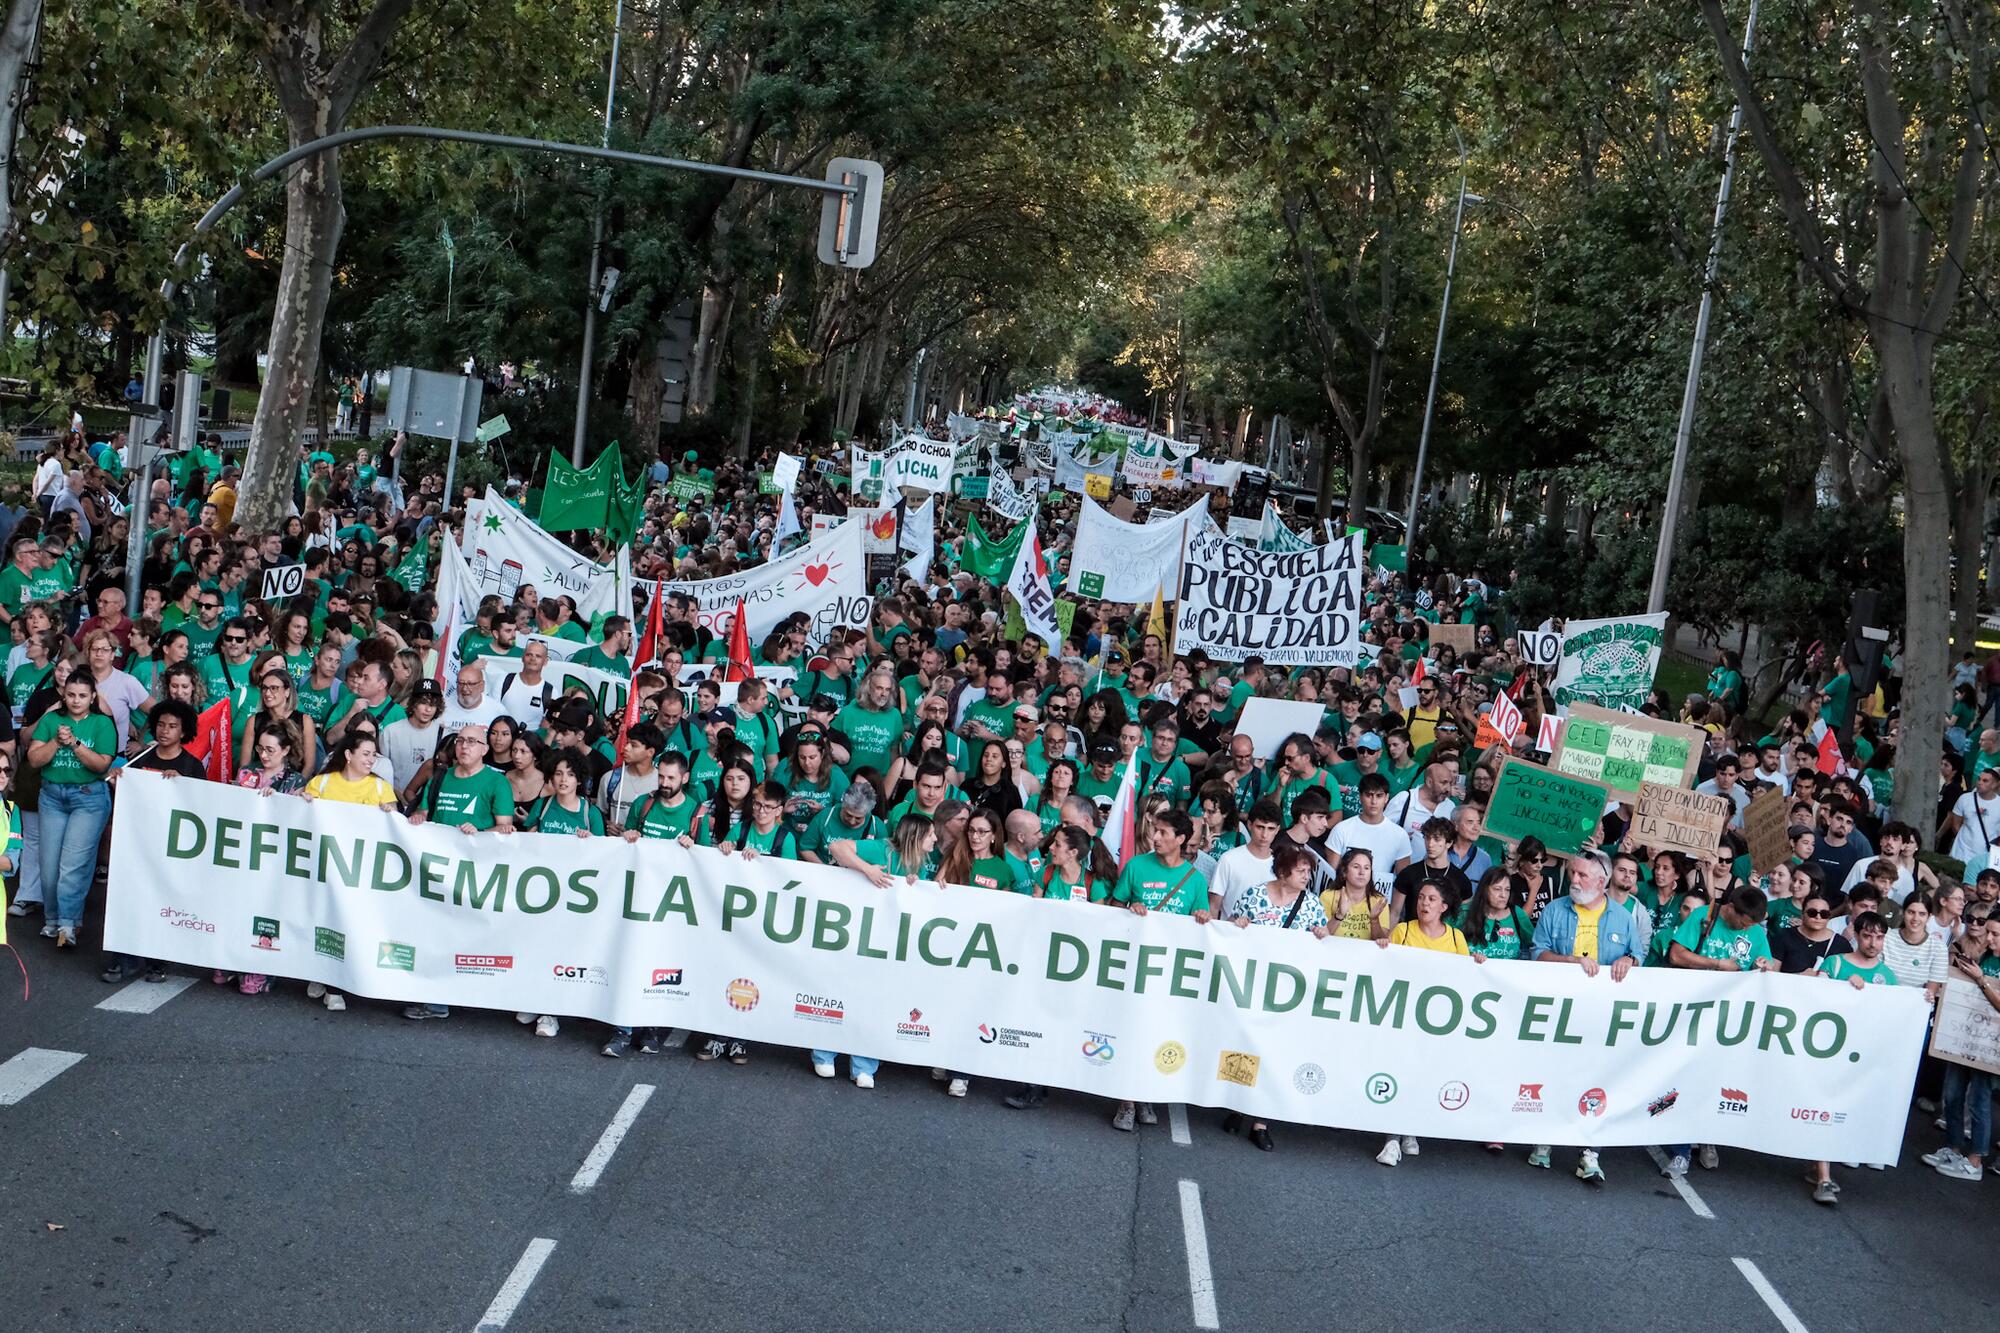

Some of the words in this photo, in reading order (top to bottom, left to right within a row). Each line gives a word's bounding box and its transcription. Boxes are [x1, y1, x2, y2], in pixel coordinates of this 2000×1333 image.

[1115, 426, 1144, 438] RAMIRO
[920, 444, 951, 459] OCHOA
[1127, 454, 1159, 469] ESCUELA
[553, 466, 580, 487] IES
[583, 489, 605, 499] scuela
[1134, 490, 1150, 501] NO
[1189, 529, 1207, 561] por
[1203, 538, 1224, 562] una
[1222, 536, 1357, 579] ESCUELA
[263, 566, 304, 597] NO
[700, 584, 773, 611] LUMNAS
[1417, 592, 1432, 608] NO
[834, 596, 869, 625] NO
[1179, 607, 1197, 631] de
[1519, 633, 1559, 662] NO
[1563, 625, 1612, 657] SOMOS
[1270, 650, 1299, 661] BRAVO
[1304, 650, 1353, 663] VALDEMORO
[1490, 690, 1519, 740] NO
[1538, 717, 1561, 748] N
[1567, 723, 1606, 747] CEE
[1611, 734, 1633, 750] FRAY
[1565, 751, 1602, 767] MADRID
[1623, 751, 1635, 761] DE
[1506, 769, 1546, 788] SOLO
[1549, 781, 1566, 793] CON
[1664, 769, 1676, 778] SE
[1516, 788, 1532, 799] NO
[1541, 792, 1551, 804] SE
[1559, 799, 1583, 813] HACE
[1642, 784, 1672, 802] SOLO
[1675, 792, 1692, 808] CON
[1656, 801, 1668, 817] SE
[1510, 803, 1577, 833] INCLUSIÓN
[1641, 817, 1656, 836] LA
[975, 874, 990, 886] UGT
[166, 809, 599, 914] DEFENDEMOS
[622, 870, 698, 926] LA
[721, 880, 1018, 975] PÚBLICA.
[1046, 931, 1502, 1039] DEFENDEMOS
[1518, 995, 1583, 1044] EL
[1605, 1000, 1860, 1063] FUTURO.
[457, 956, 495, 965] CCOO
[553, 965, 587, 979] CGT
[656, 972, 679, 982] CNT
[667, 988, 690, 996] Sindical
[796, 993, 844, 1010] CONFAPA
[897, 1022, 930, 1031] CONTRA
[897, 1028, 930, 1037] CORRIENTE
[1000, 1027, 1043, 1039] COORDINADORA
[999, 1040, 1030, 1048] SOCIALISTA
[1000, 1034, 1021, 1042] JUVENIL
[1091, 1035, 1108, 1045] TEA
[1719, 1101, 1748, 1113] STEM
[1790, 1107, 1818, 1121] UGT
